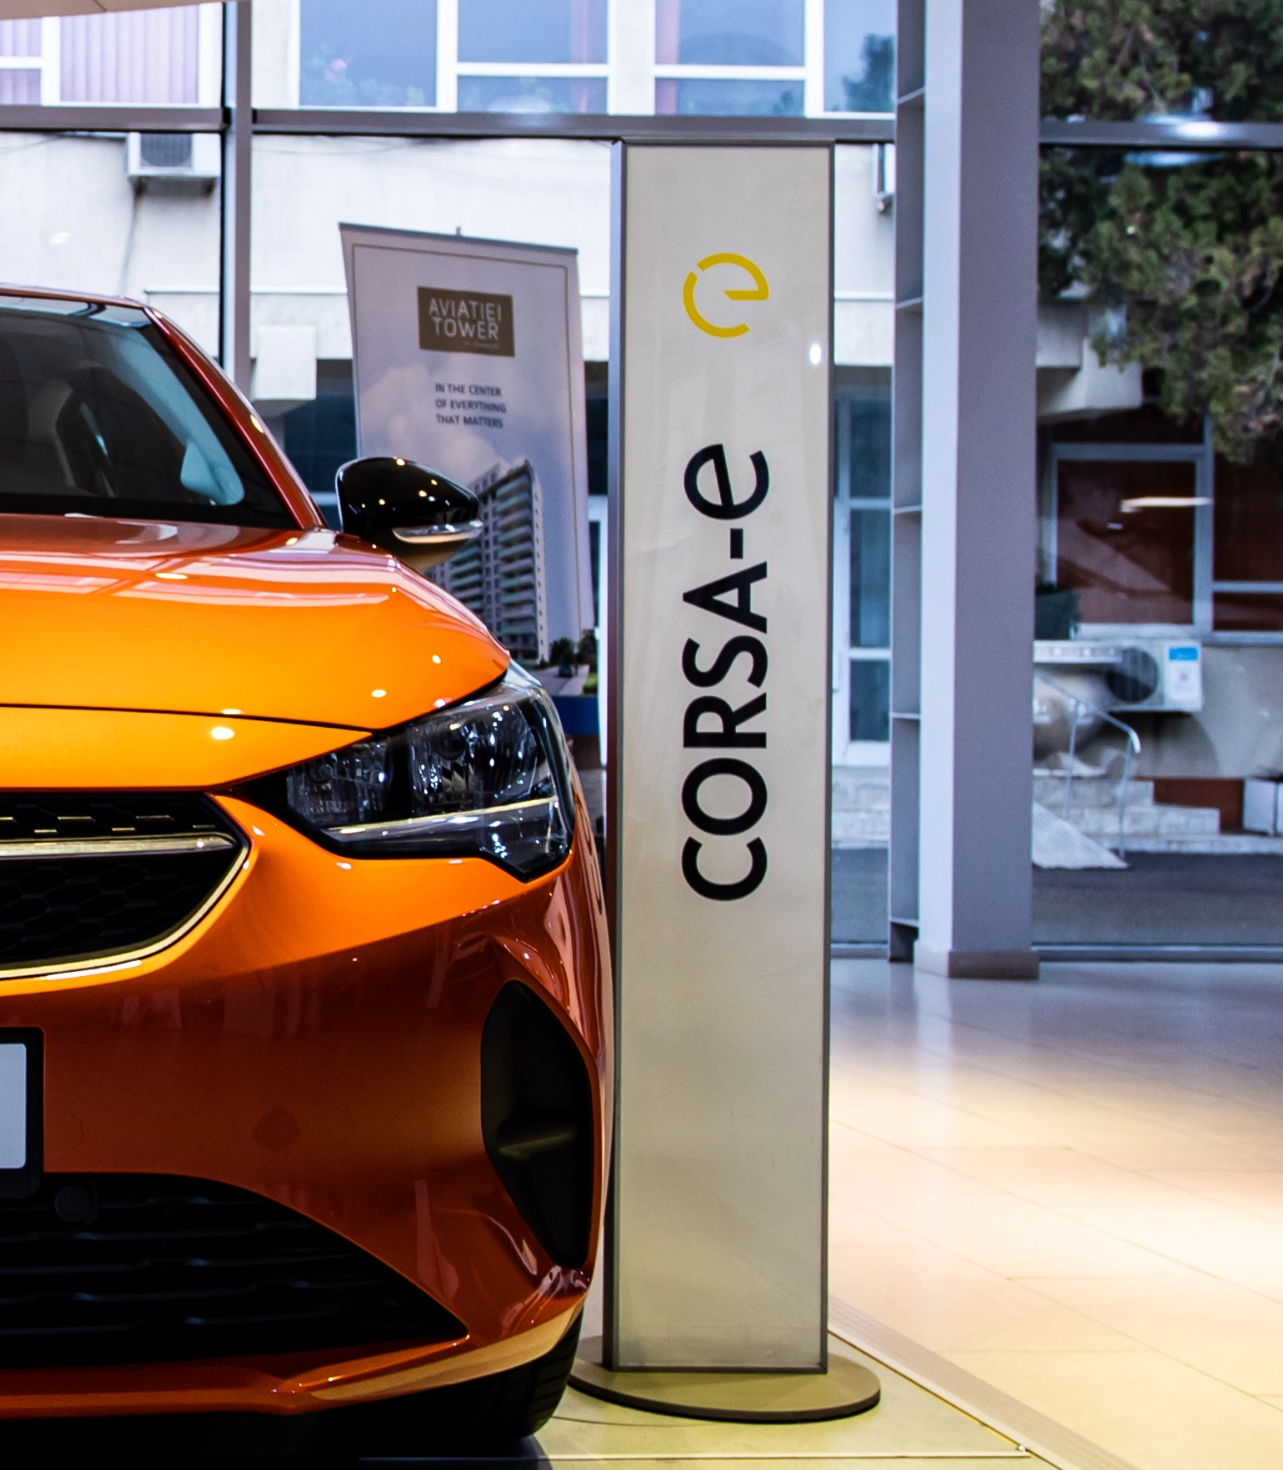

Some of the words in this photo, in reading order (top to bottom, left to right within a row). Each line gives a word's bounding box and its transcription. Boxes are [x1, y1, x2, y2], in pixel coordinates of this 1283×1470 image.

[429, 297, 502, 322] AVIATIEI
[432, 316, 499, 341] TOWER
[435, 383, 445, 393] IN
[448, 384, 465, 395] THE
[468, 385, 502, 397] CENTER
[435, 398, 447, 408] OF
[450, 400, 507, 413] EVERYTHING
[436, 413, 460, 425] THAT
[463, 415, 504, 429] MATTERS
[682, 444, 770, 902] CORSA-e
